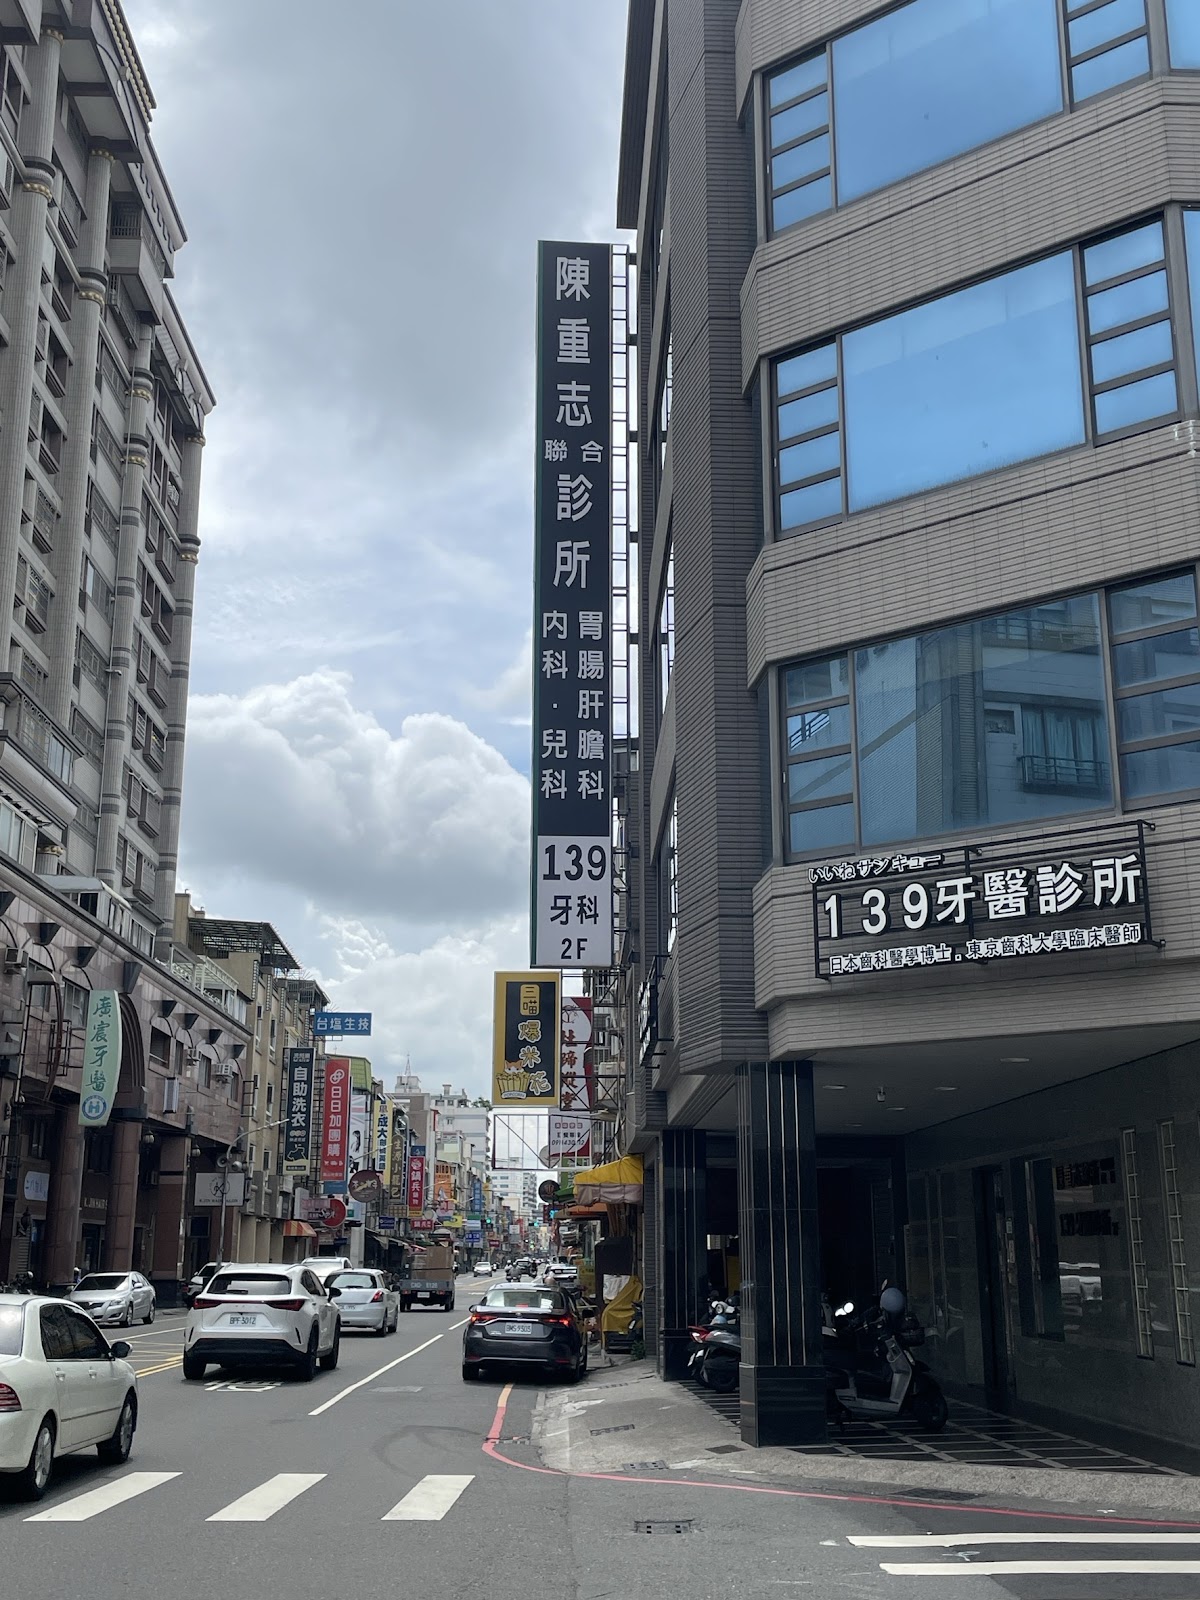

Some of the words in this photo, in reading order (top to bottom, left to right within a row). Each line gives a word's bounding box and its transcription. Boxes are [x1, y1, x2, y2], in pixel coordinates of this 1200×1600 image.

[556, 256, 593, 428] 陳重志
[544, 439, 604, 463] 聯合
[552, 473, 594, 589] 診所
[577, 610, 604, 800] 胃腸肝膽科
[542, 844, 607, 881] 139
[808, 854, 942, 884] いいねサンキュー
[550, 894, 600, 926] 牙科
[560, 937, 588, 960] 2F
[317, 1017, 370, 1031] 台塩生技
[518, 1020, 552, 1095] 爆米花
[290, 1066, 308, 1127] 自助洗衣
[327, 1086, 342, 1157] 日日加團購
